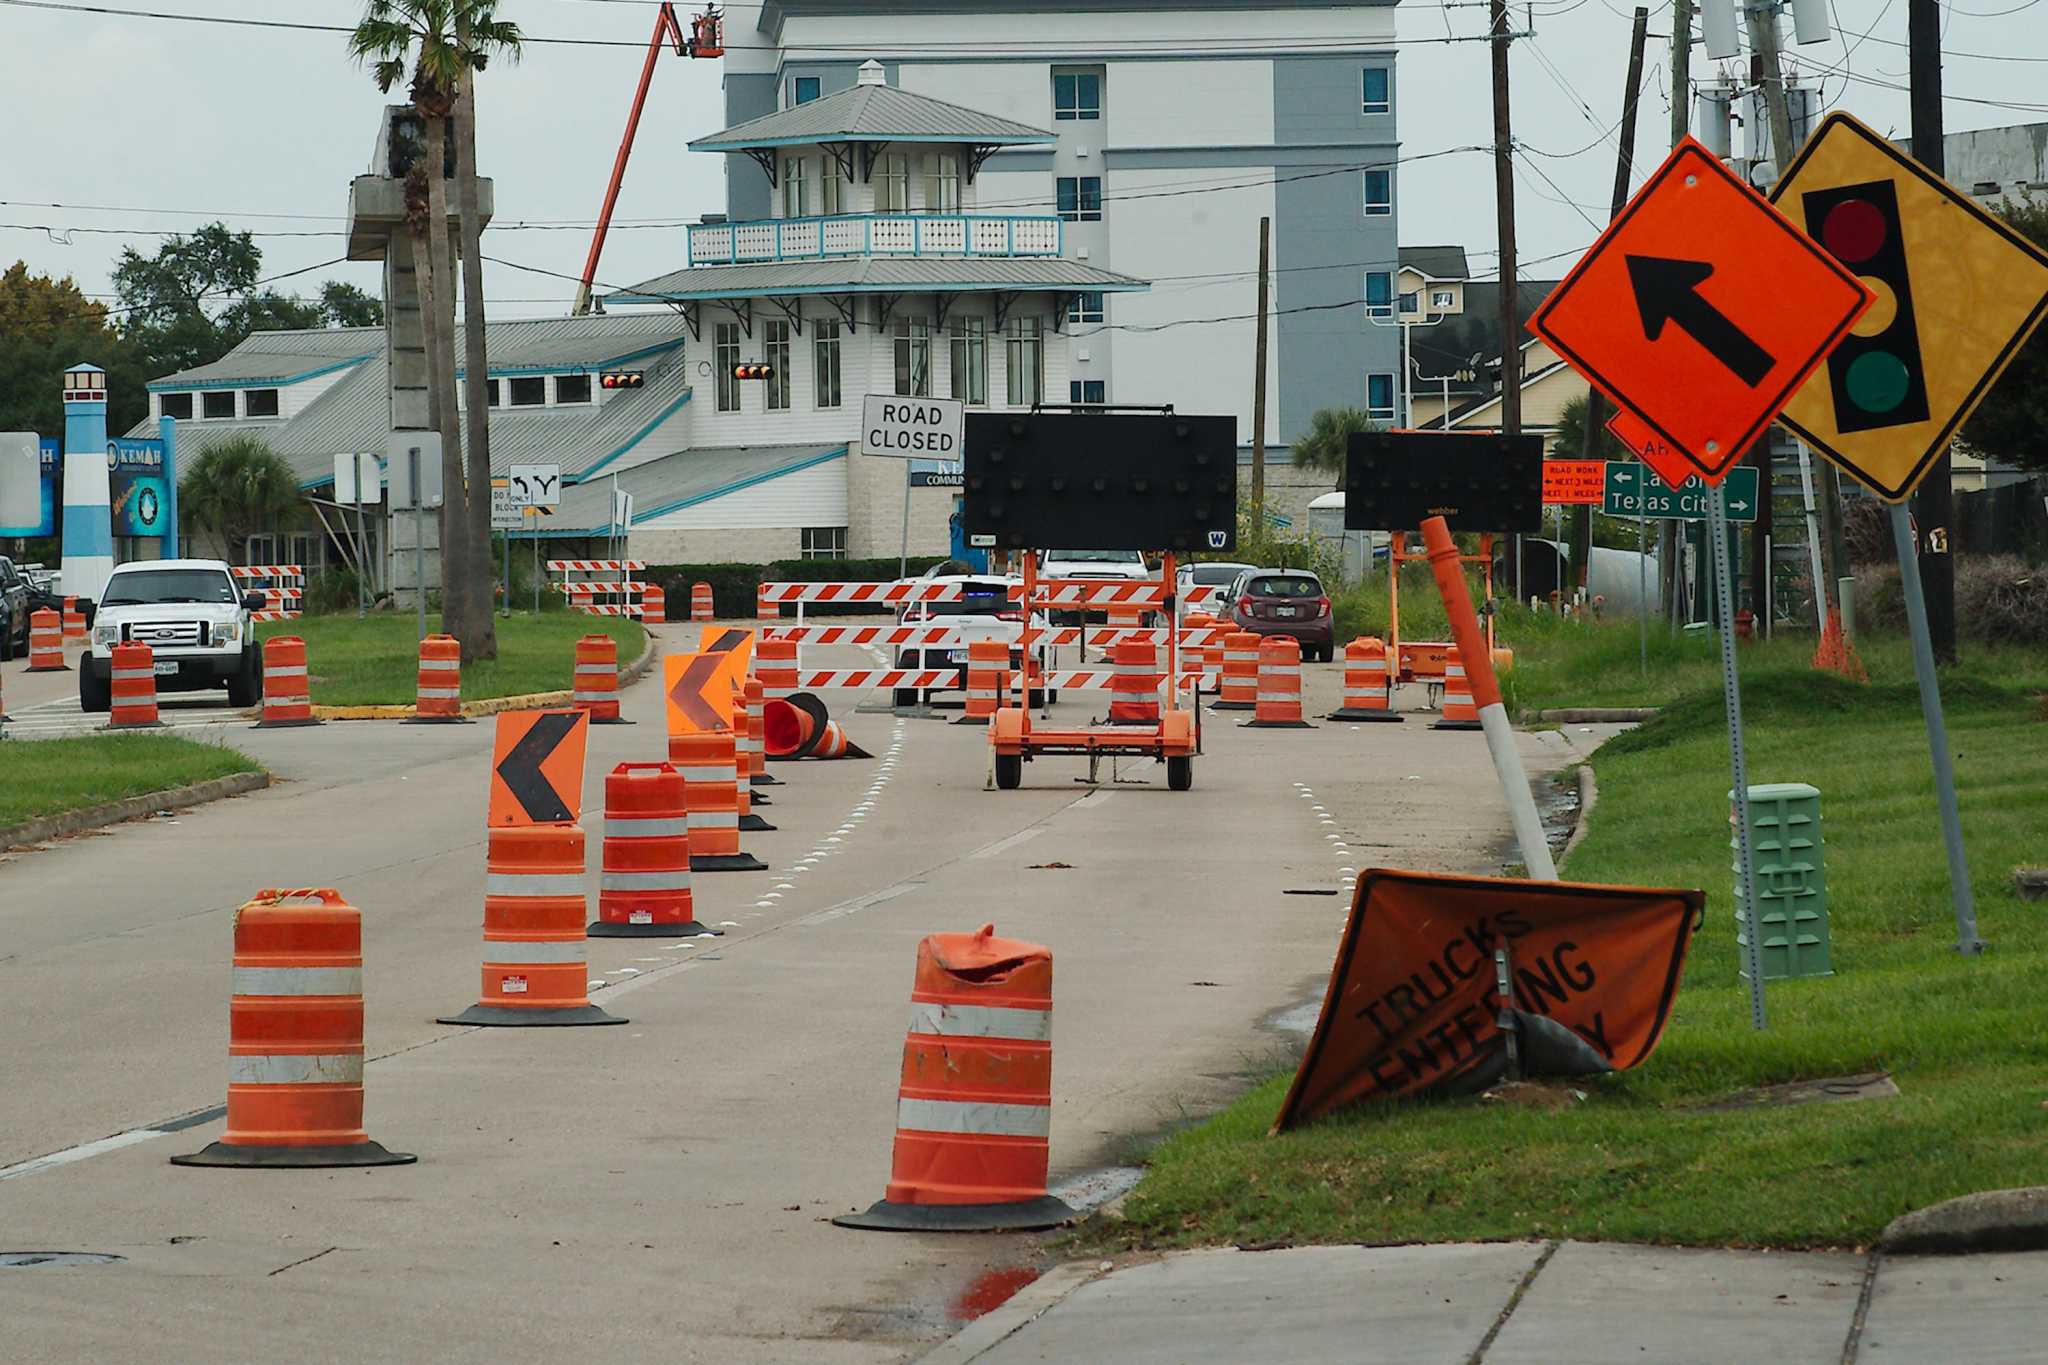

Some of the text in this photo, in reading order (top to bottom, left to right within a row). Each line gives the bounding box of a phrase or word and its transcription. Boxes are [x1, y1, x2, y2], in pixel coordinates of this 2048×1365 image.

[883, 404, 942, 425] ROAD
[870, 429, 953, 451] CLOSED
[1612, 493, 1709, 513] Texas Cit
[1356, 909, 1535, 1041] TRUCKS
